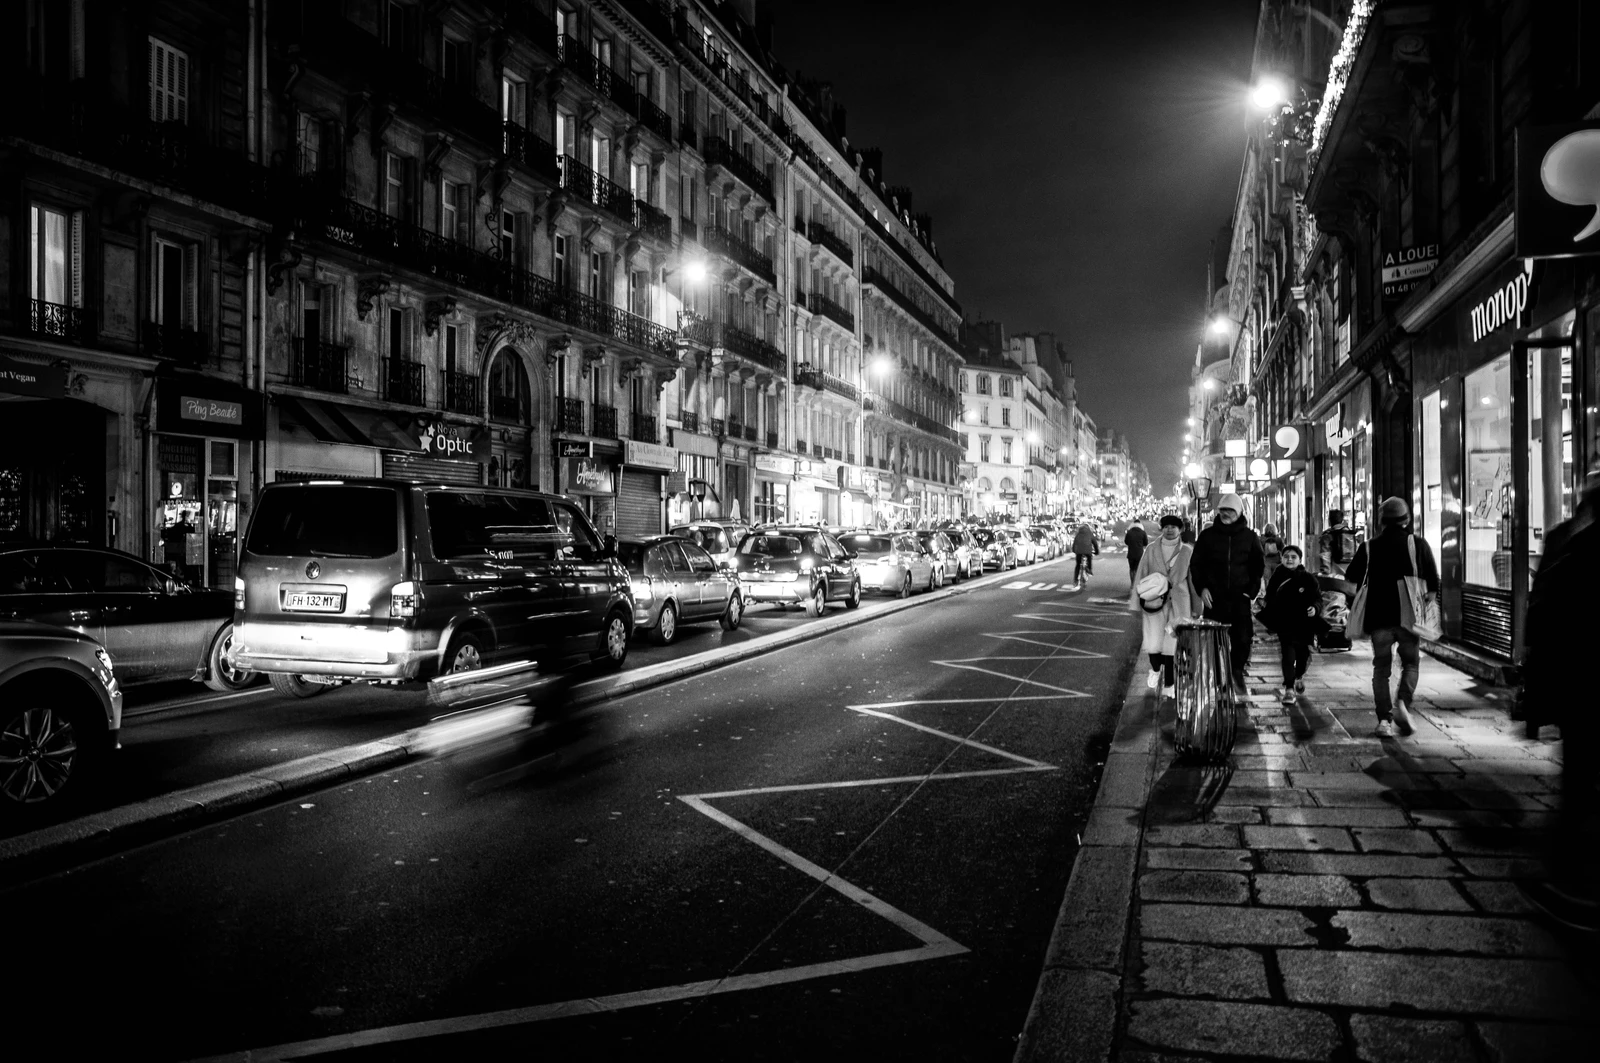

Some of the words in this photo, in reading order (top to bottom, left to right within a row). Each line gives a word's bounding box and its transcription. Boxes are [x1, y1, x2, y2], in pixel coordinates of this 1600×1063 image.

[1385, 252, 1395, 266] A
[9, 371, 36, 383] Vegan
[186, 400, 207, 420] Ping
[209, 403, 237, 418] Beauté
[437, 434, 473, 456] Optic
